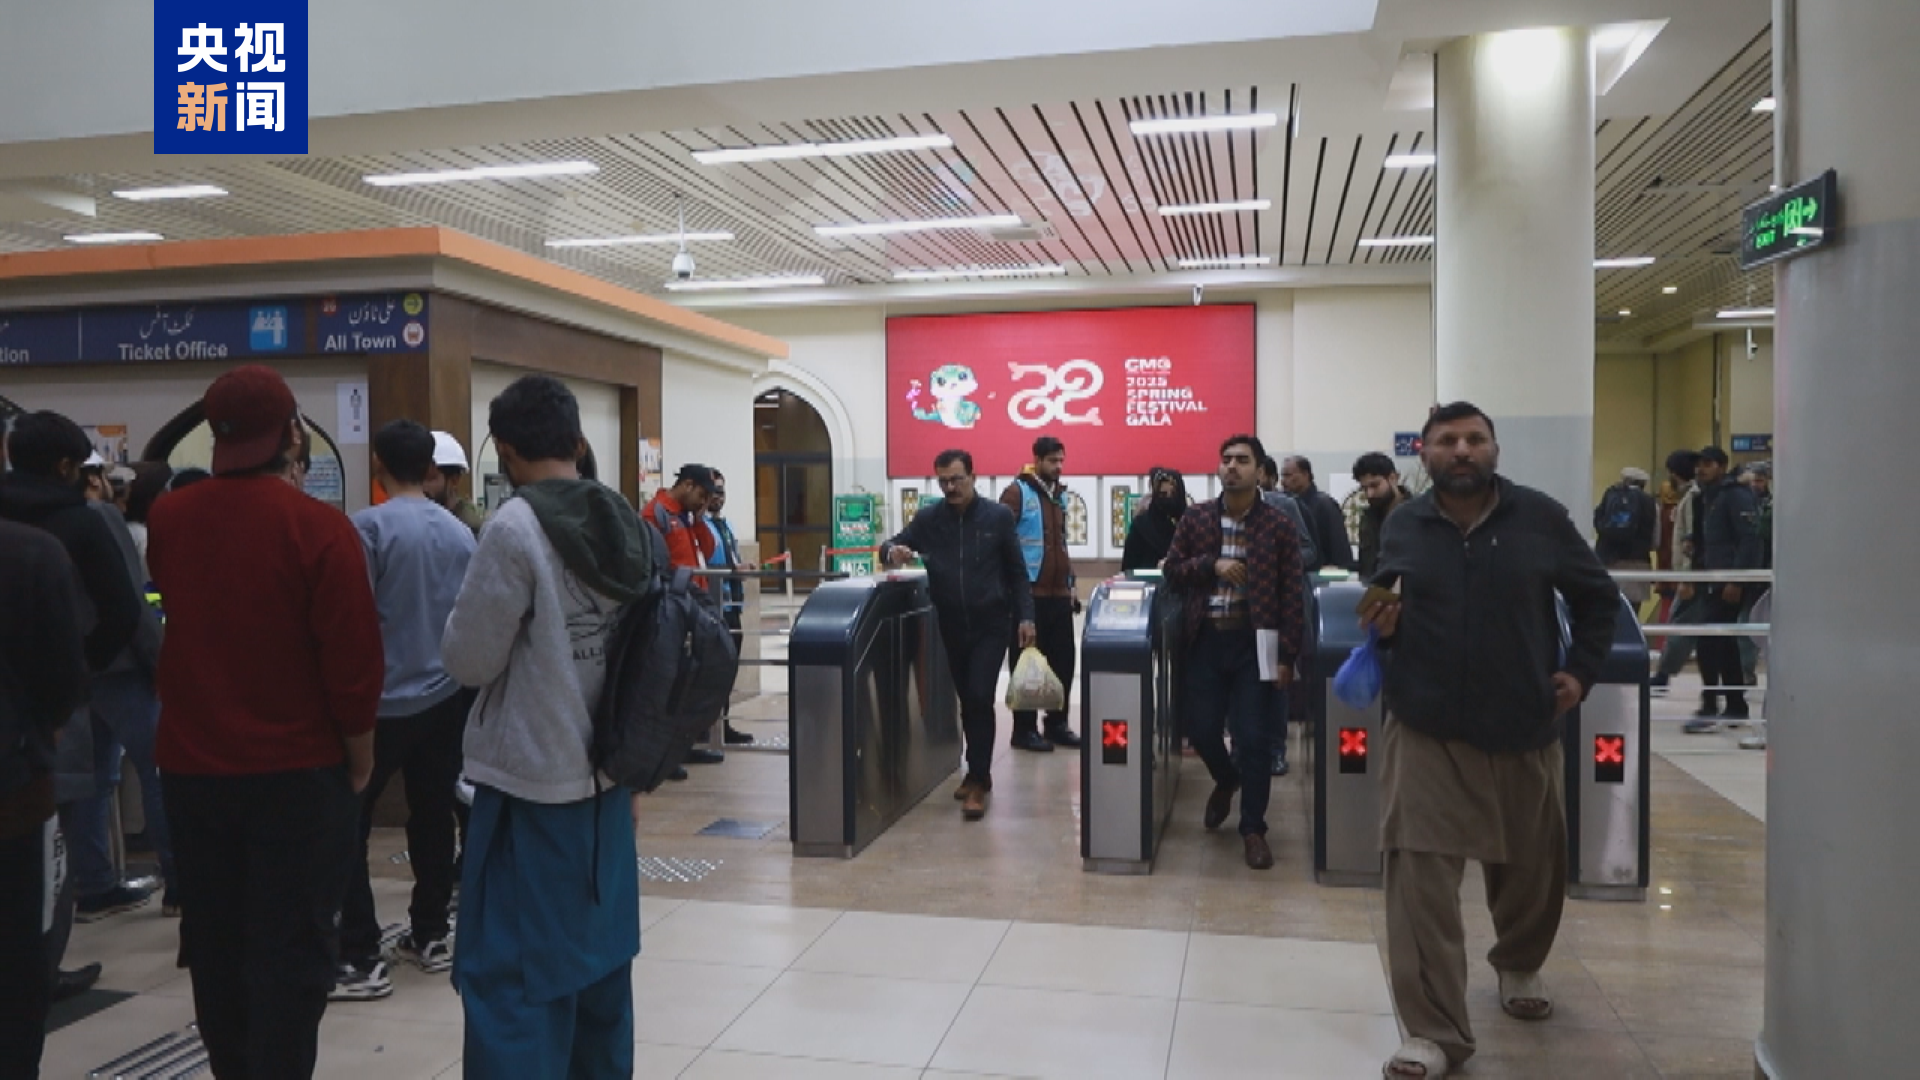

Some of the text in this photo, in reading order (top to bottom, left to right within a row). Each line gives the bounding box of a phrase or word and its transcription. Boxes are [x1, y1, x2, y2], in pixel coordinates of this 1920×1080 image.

[351, 331, 397, 350] Town
[117, 341, 228, 360] Ticket Office
[1124, 356, 1172, 374] CMG
[1125, 376, 1168, 387] 2025
[1126, 387, 1193, 400] SPRING
[1126, 400, 1208, 414] FESTIVAL
[1125, 413, 1172, 426] GALA
